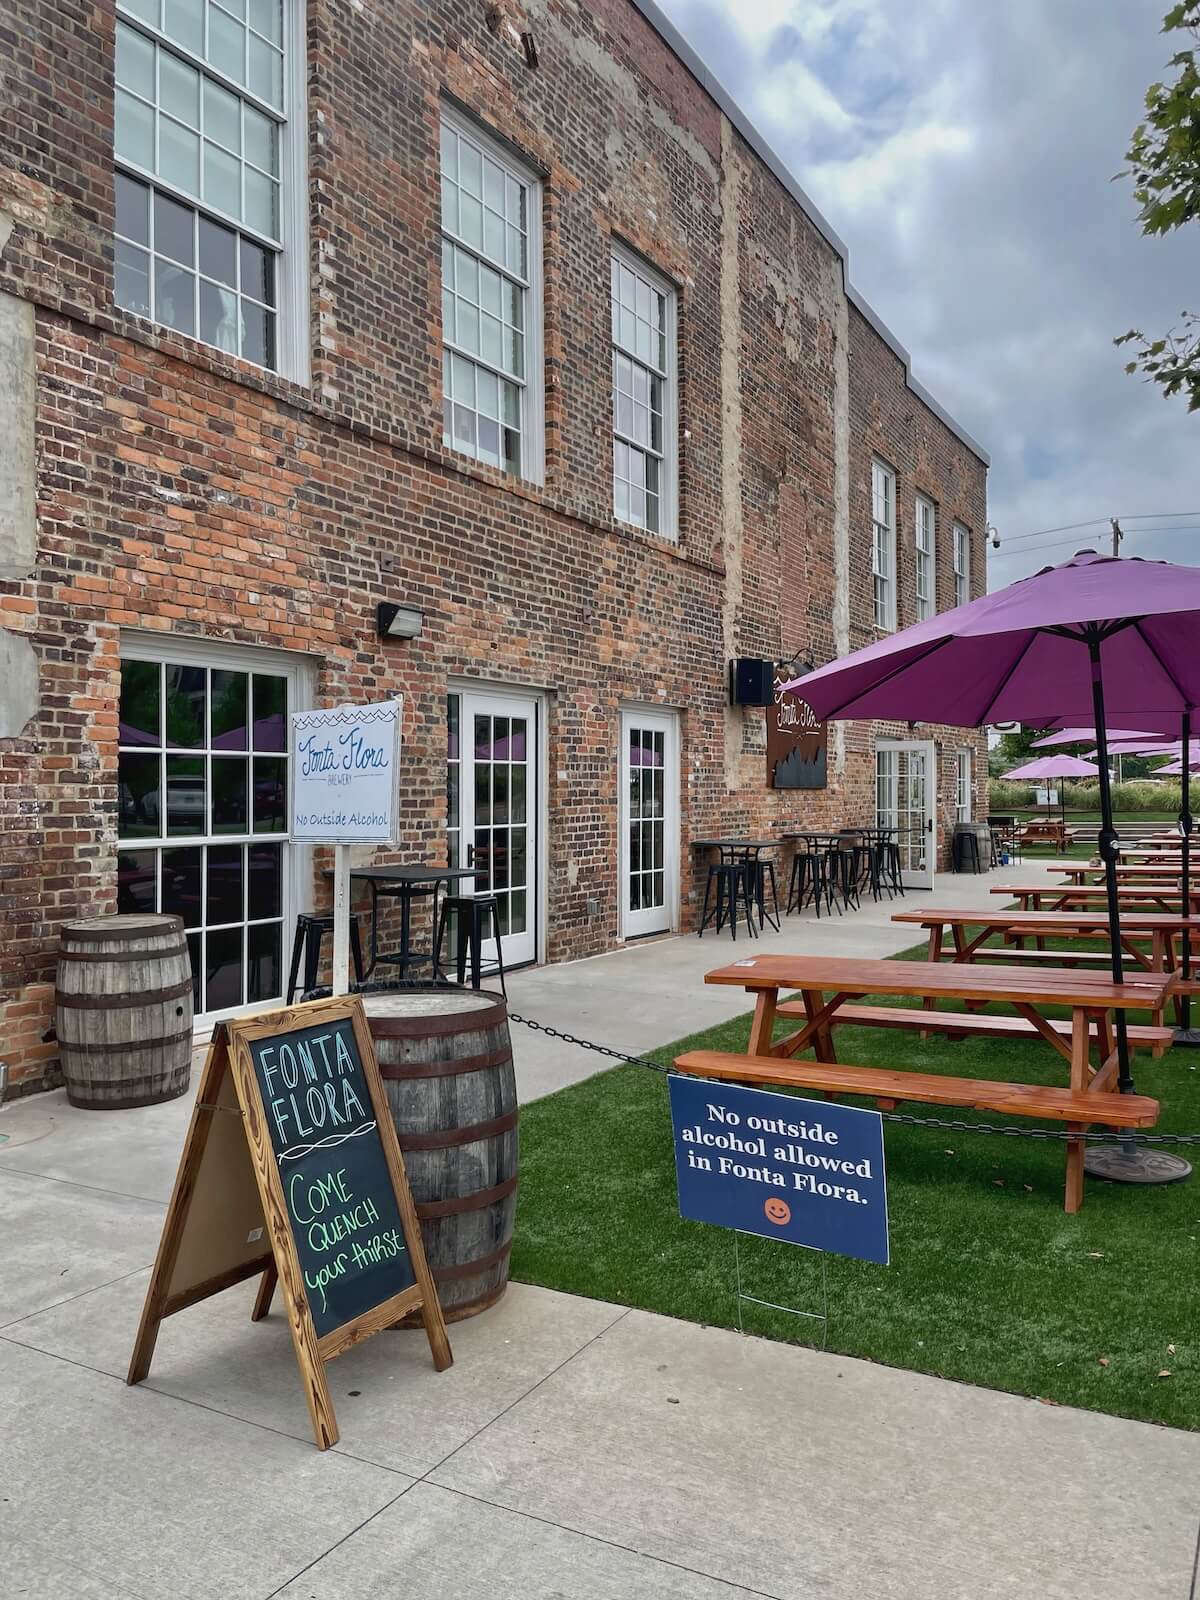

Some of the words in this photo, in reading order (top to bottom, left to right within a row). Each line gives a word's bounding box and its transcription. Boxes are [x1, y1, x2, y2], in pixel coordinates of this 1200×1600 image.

[298, 735, 339, 776] Fonta
[339, 727, 389, 770] Flora
[296, 814, 307, 826] No
[310, 811, 346, 826] Outside
[350, 811, 388, 826] Alcohol
[259, 1031, 355, 1097] FONTA
[271, 1078, 366, 1144] FLORA
[706, 1103, 740, 1126] No
[747, 1115, 839, 1145] outside
[681, 1125, 767, 1158] alcohol
[774, 1143, 873, 1179] allowed
[688, 1150, 712, 1171] in
[718, 1157, 786, 1187] Fonta
[792, 1172, 868, 1205] Flora.
[290, 1168, 353, 1224] COME
[308, 1198, 380, 1252] QUENCH
[305, 1253, 348, 1314] your
